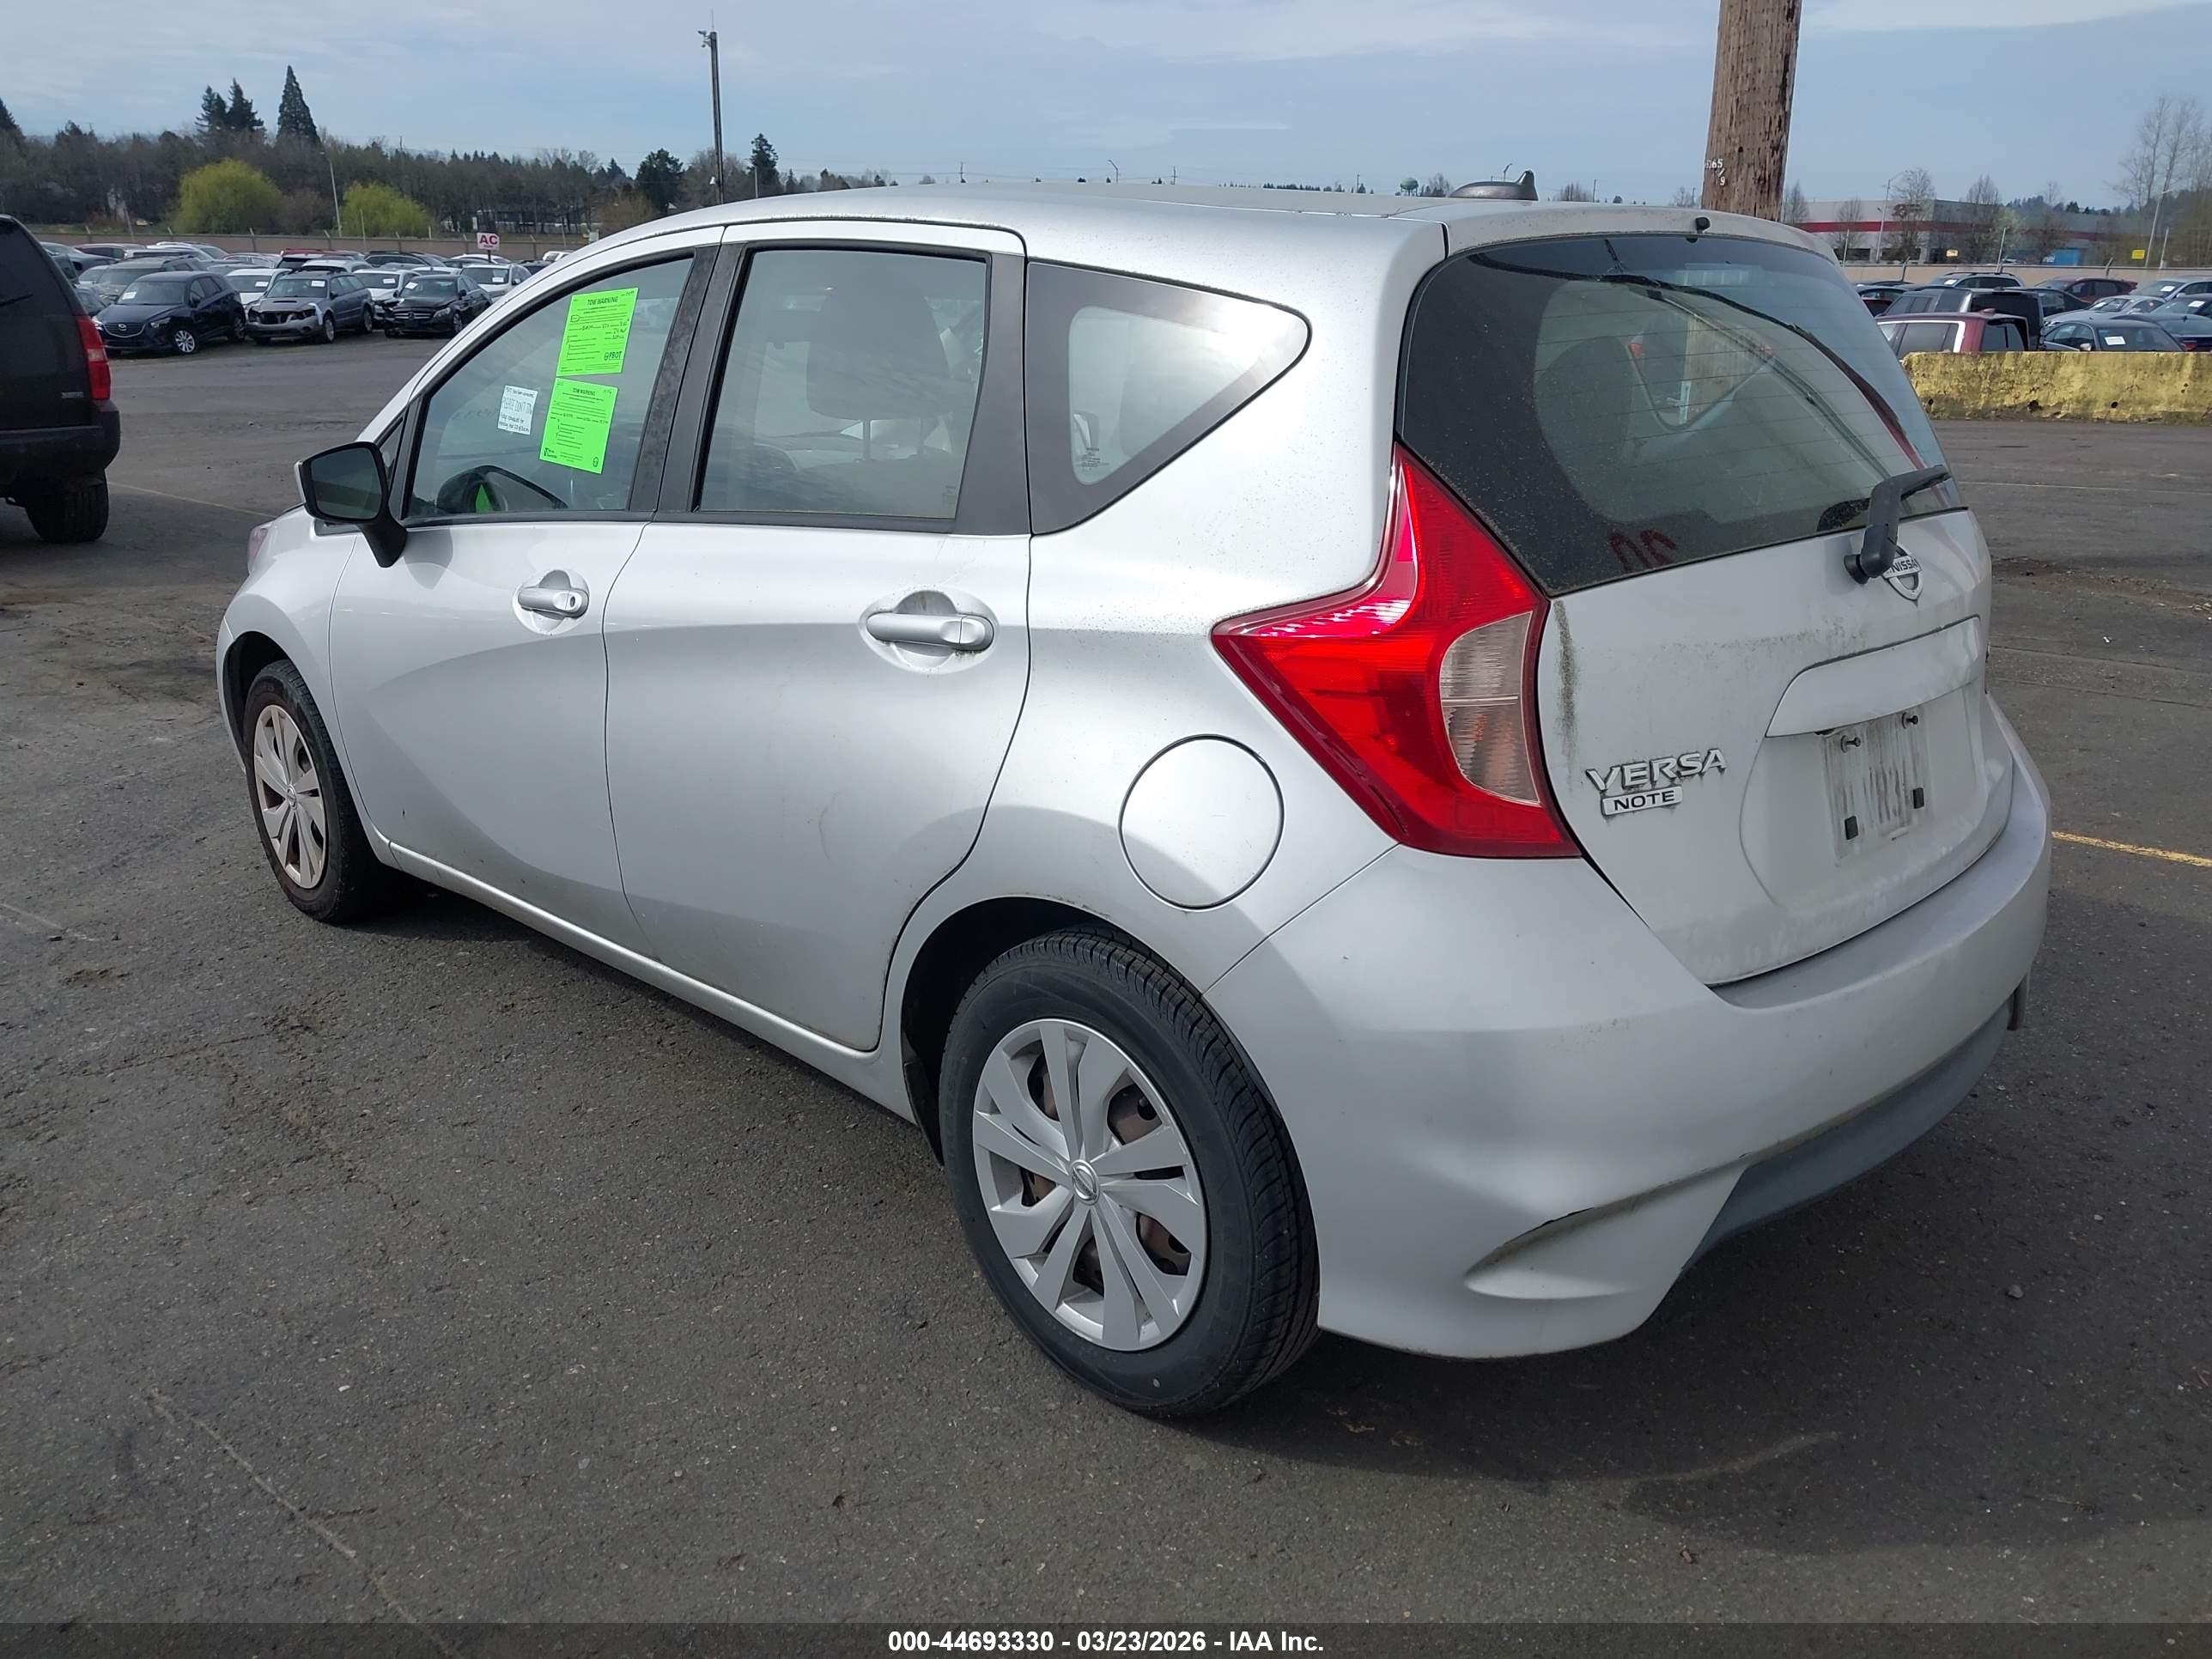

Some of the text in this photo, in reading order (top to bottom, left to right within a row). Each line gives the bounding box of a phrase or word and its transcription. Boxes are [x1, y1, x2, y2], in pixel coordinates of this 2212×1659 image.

[479, 234, 498, 245] AC
[1586, 748, 1727, 792] VERSA
[1613, 790, 1675, 811] NOTE
